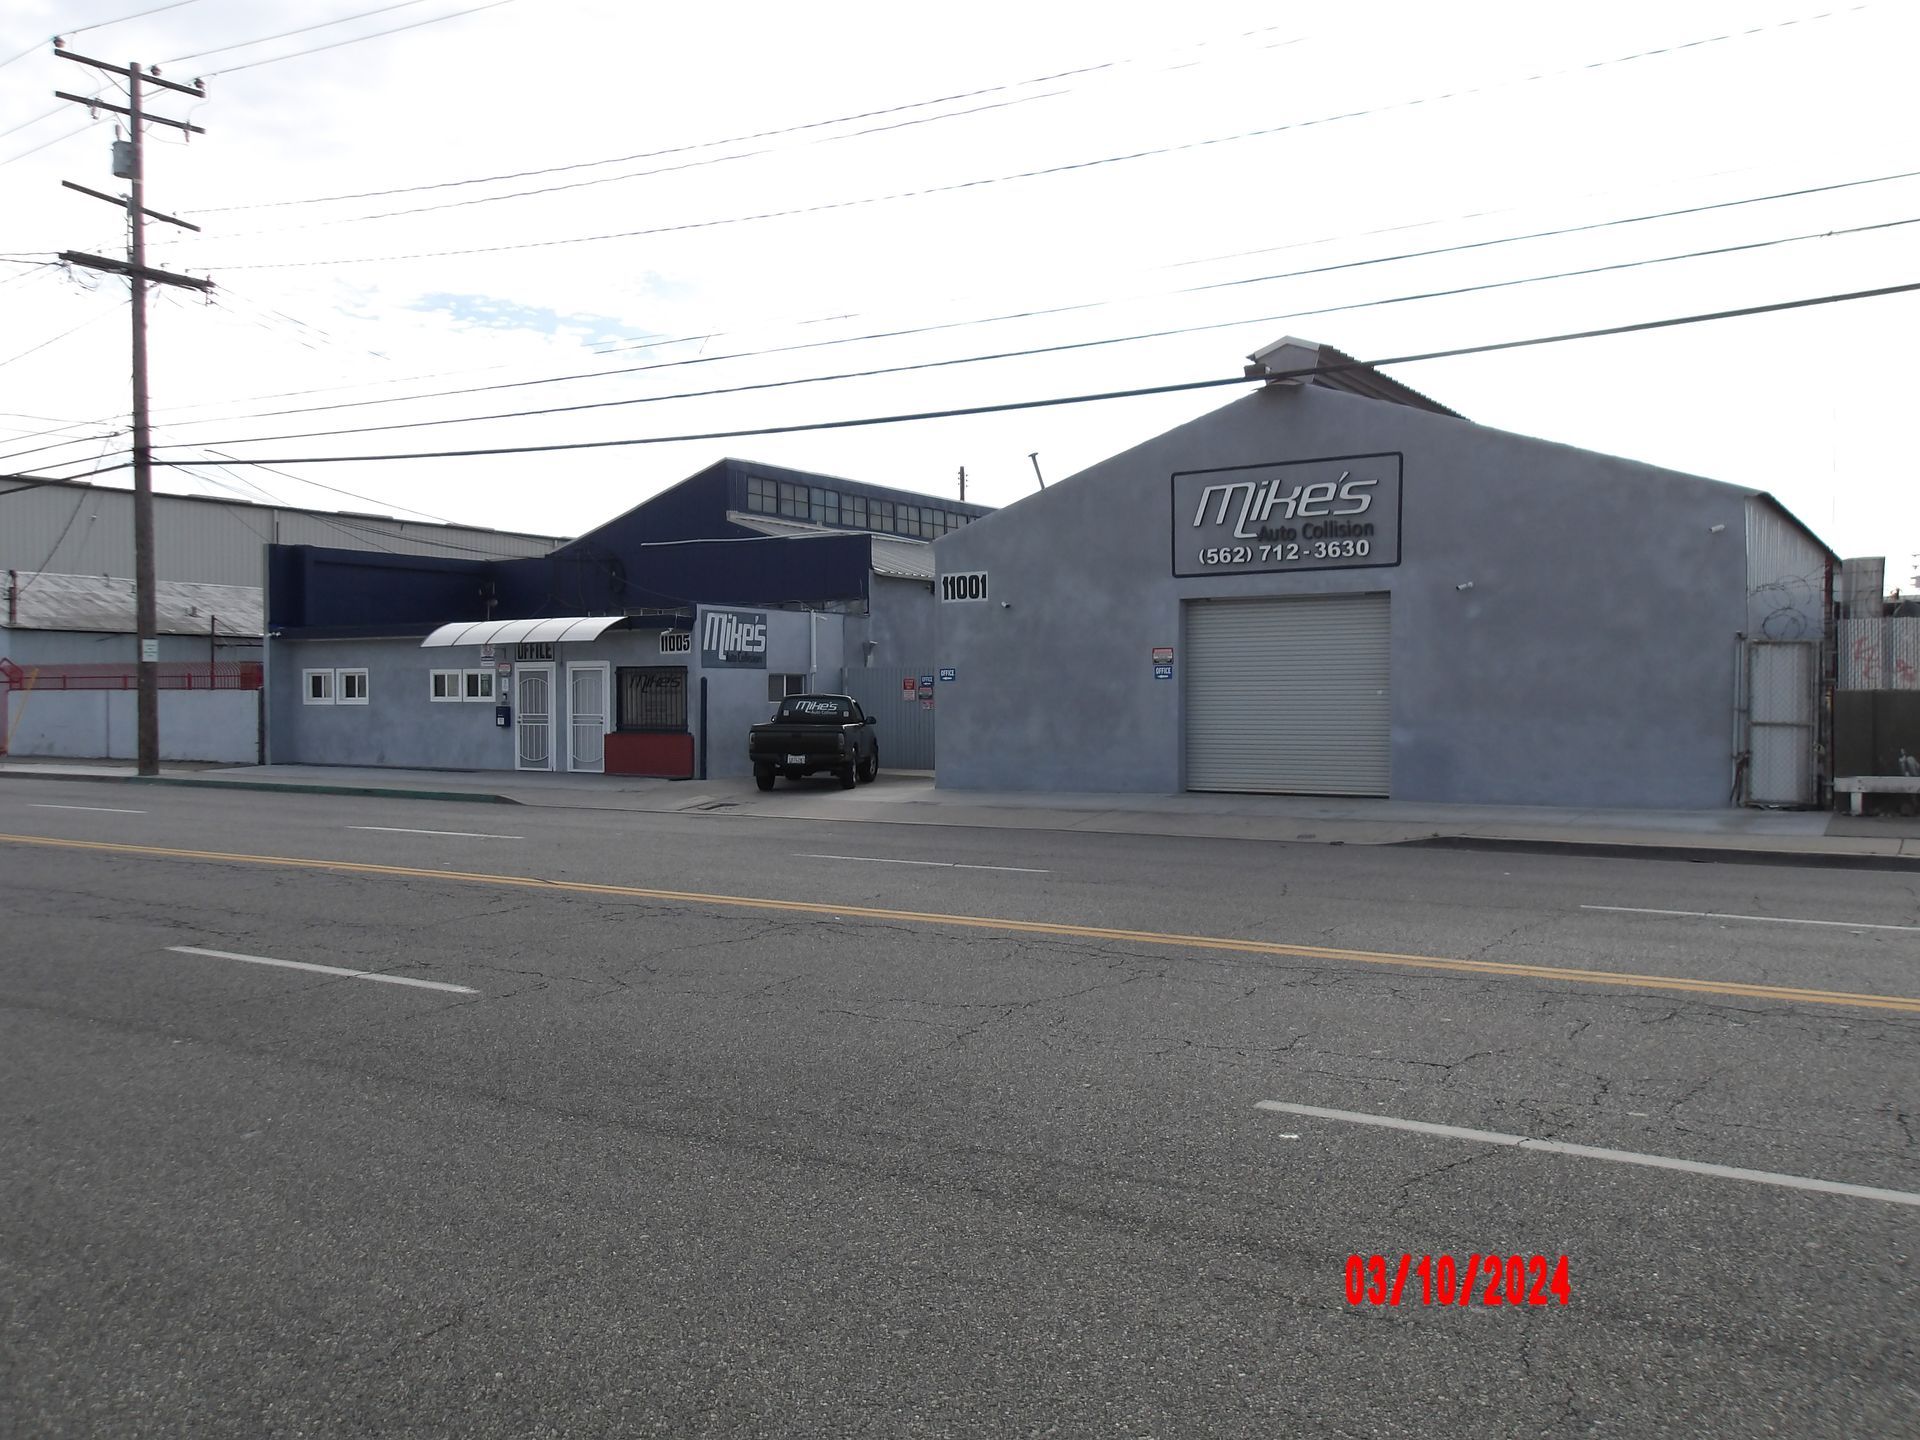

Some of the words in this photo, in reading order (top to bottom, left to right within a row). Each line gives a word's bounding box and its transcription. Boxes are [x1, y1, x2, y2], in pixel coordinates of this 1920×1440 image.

[1193, 472, 1378, 538] Mike's
[1258, 525, 1297, 541] Auto
[1302, 520, 1374, 540] Collision
[1198, 547, 1252, 565] (562)
[942, 574, 987, 600] 11001
[661, 634, 690, 652] 11005
[703, 612, 767, 660] Mike's
[940, 669, 955, 677] OFFICE
[795, 701, 839, 713] Mike's
